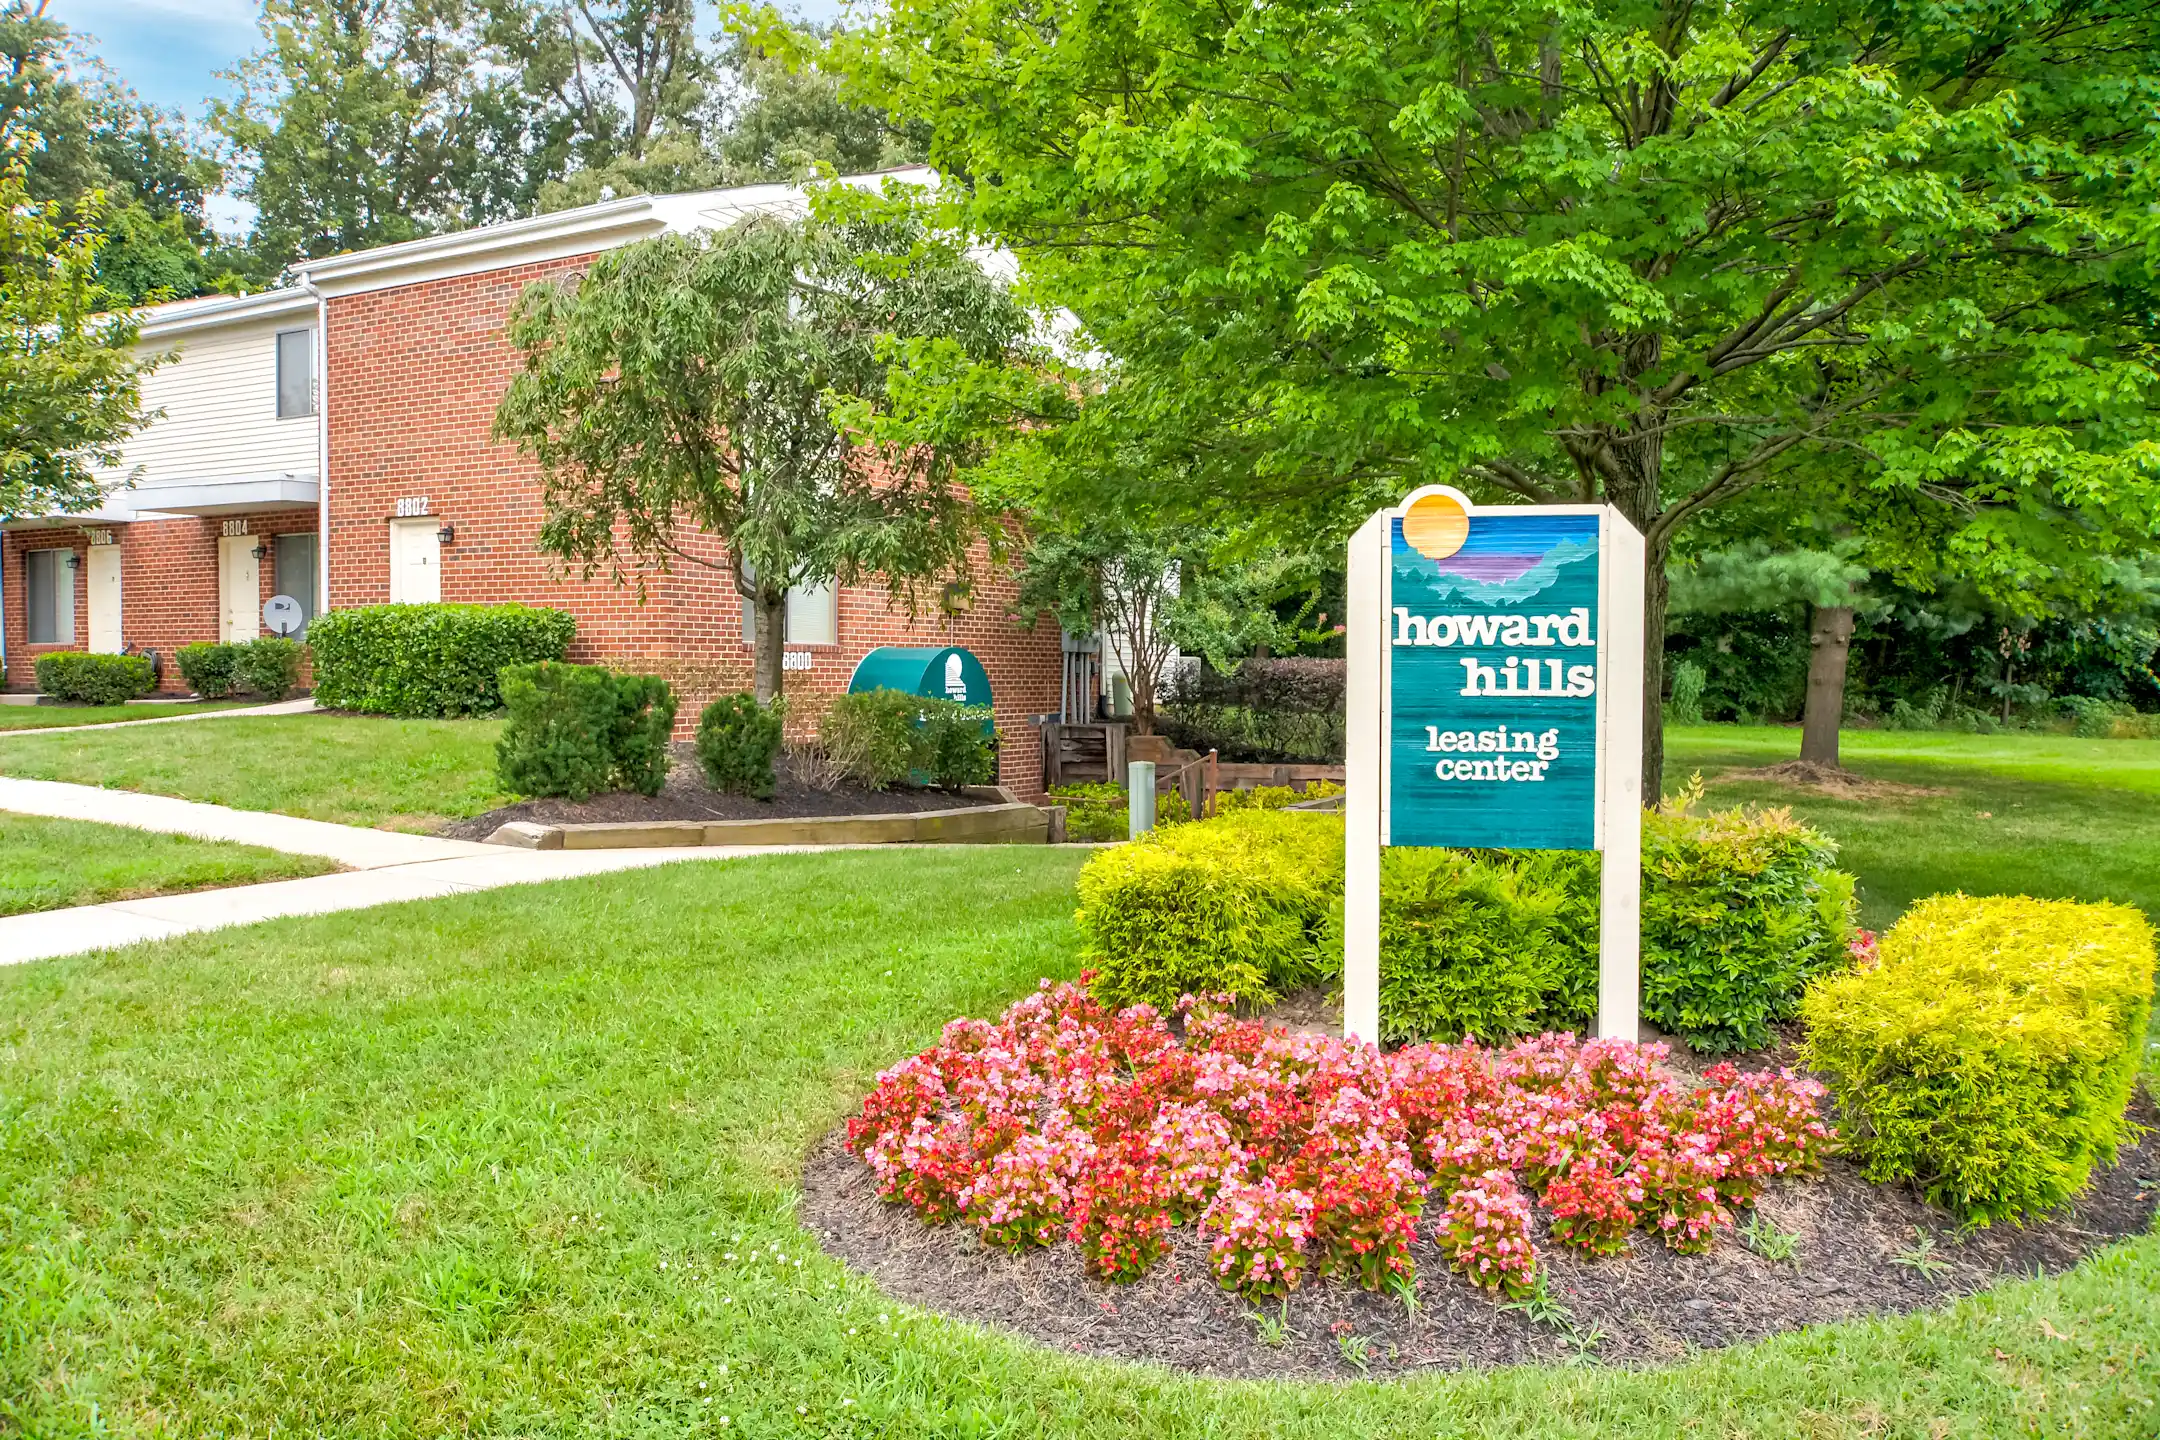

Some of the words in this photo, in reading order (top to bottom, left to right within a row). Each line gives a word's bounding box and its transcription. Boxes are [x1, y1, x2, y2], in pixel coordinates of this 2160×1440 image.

[397, 496, 429, 517] 8802
[222, 519, 248, 537] 8804
[1392, 607, 1596, 647] howard
[782, 651, 812, 670] 8800
[1460, 656, 1597, 697] hills
[1425, 725, 1560, 760] leasing
[1436, 755, 1549, 782] center
